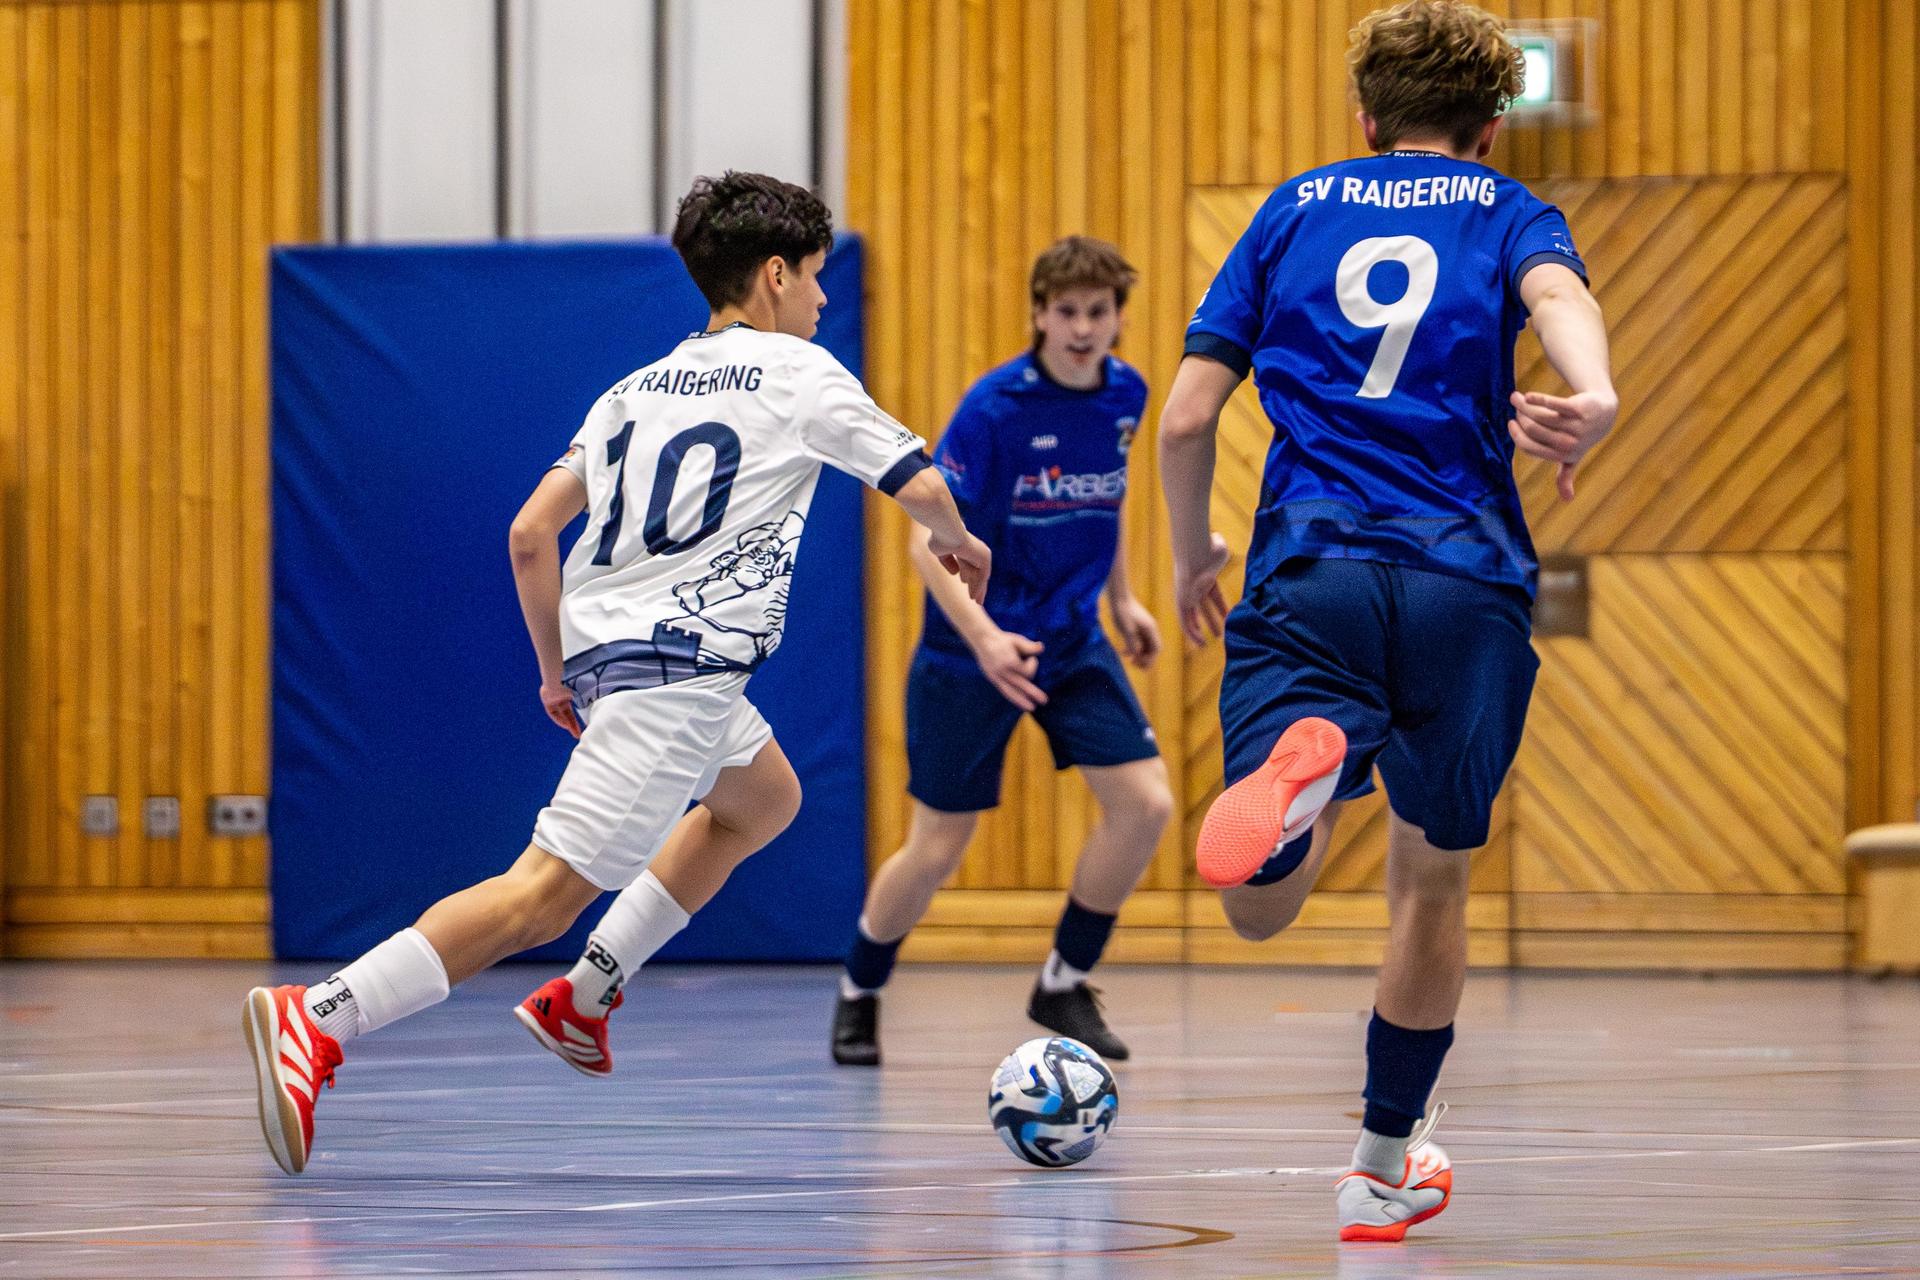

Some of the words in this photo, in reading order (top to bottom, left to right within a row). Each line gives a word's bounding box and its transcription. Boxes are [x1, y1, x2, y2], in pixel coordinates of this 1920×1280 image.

[1297, 176, 1334, 206] SV
[1342, 175, 1496, 208] RAIGERING
[1336, 235, 1439, 399] 9
[638, 365, 763, 396] RAIGERING
[591, 420, 742, 566] 10
